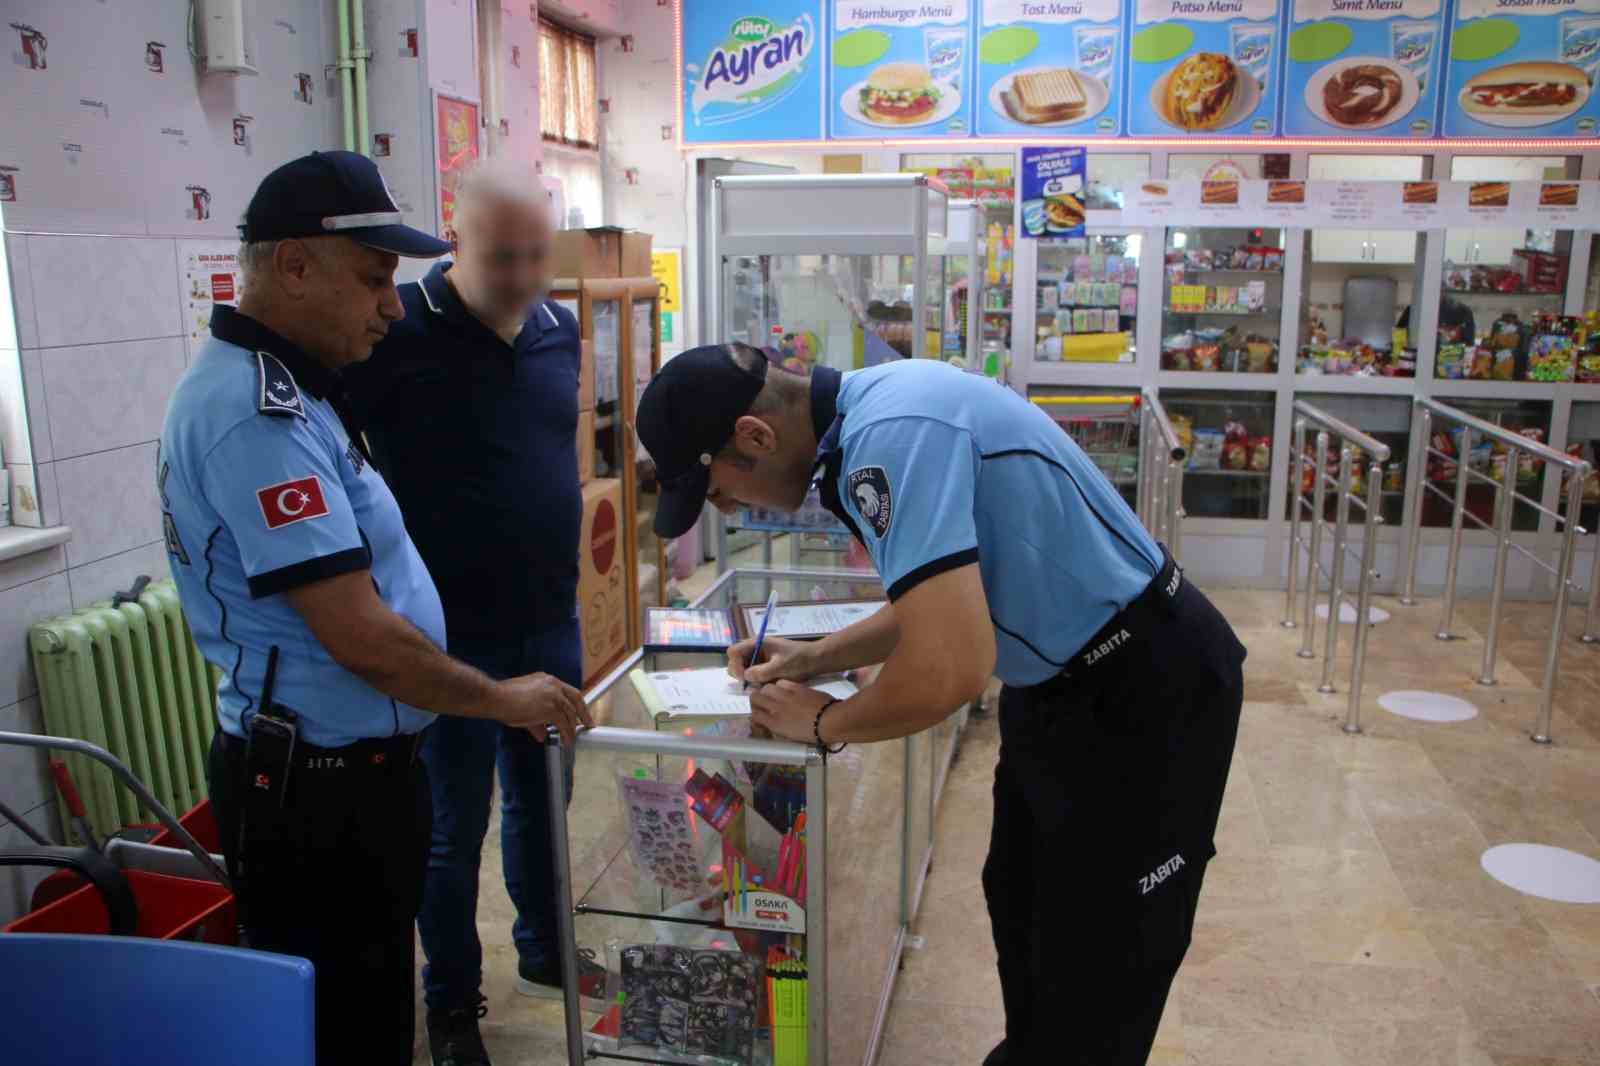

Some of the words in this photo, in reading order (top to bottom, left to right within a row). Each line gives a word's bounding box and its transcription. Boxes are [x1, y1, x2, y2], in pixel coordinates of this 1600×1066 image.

[851, 7, 917, 21] Hamburger
[919, 6, 953, 17] Menü
[1048, 3, 1082, 14] Menü
[1172, 1, 1204, 13] Patso
[1207, 0, 1242, 12] Menü
[704, 30, 803, 91] Ayran
[1083, 629, 1131, 665] ZABITA
[1138, 853, 1186, 895] ZABITA
